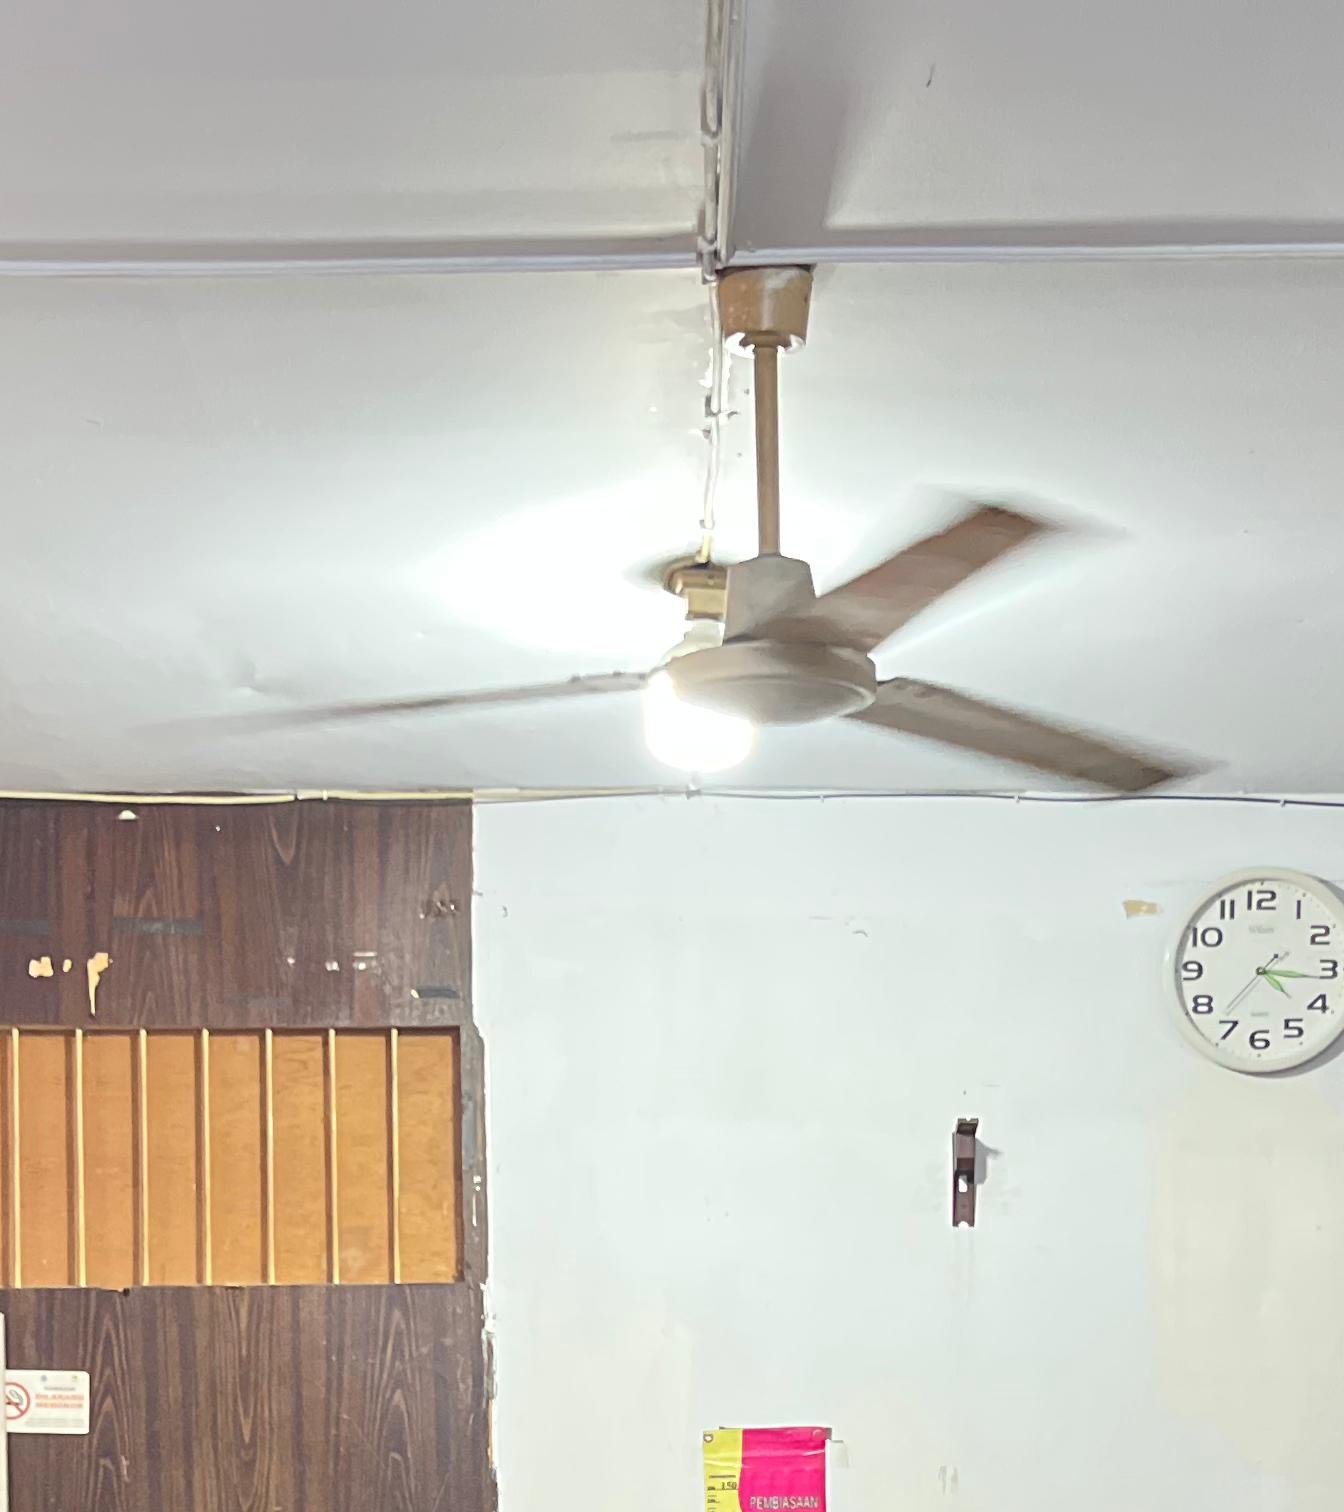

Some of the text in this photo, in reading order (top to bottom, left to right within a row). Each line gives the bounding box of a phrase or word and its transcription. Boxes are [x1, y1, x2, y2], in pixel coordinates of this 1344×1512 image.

[1219, 899, 1235, 920] 11
[1246, 890, 1277, 911] 12
[1296, 900, 1301, 920] 1
[1192, 927, 1223, 948] 10
[1310, 925, 1330, 945] 2
[1182, 960, 1203, 981] 9
[1319, 959, 1338, 980] 3
[1191, 994, 1214, 1015] 8
[1306, 994, 1329, 1014] 4
[1218, 1020, 1239, 1040] 7
[1283, 1018, 1304, 1038] 5
[1249, 1029, 1271, 1050] 6
[750, 1496, 818, 1510] PEMBIASAAN
